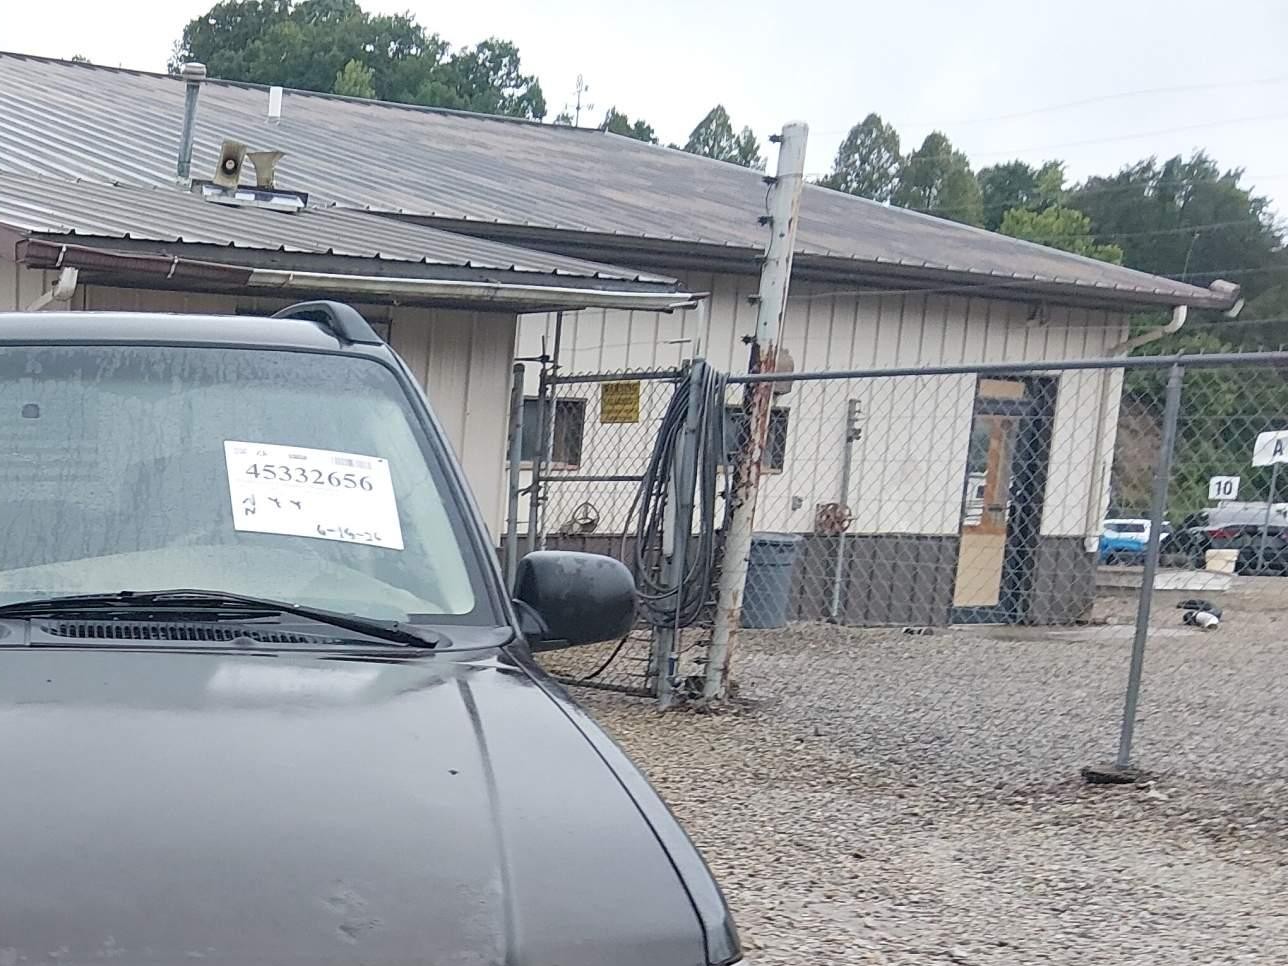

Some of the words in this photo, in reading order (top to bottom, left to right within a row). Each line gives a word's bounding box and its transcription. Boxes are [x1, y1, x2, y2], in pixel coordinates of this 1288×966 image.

[1272, 439, 1284, 457] A
[244, 463, 374, 492] 45332656
[1214, 480, 1233, 496] 10
